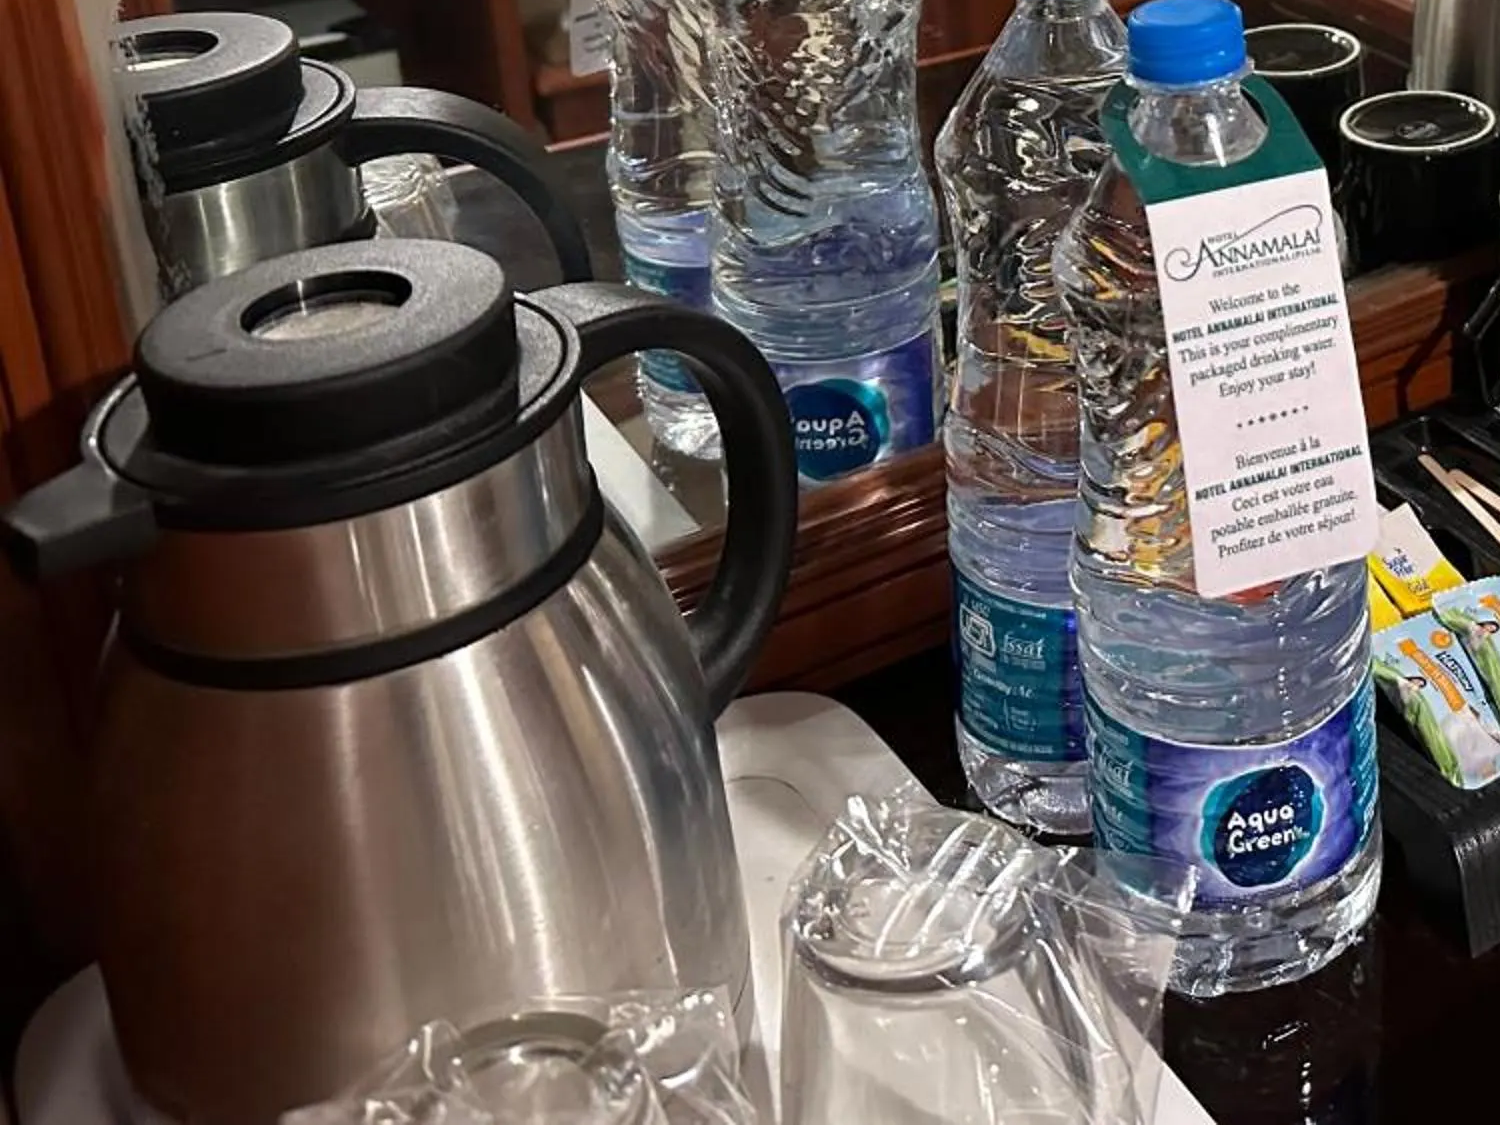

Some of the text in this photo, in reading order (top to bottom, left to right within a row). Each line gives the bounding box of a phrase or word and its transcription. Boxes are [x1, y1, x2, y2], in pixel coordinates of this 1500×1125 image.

[1197, 227, 1322, 269] ANNAMALAI
[1172, 293, 1340, 343] HOTEL ANNAMALAI INTERNATIONAL
[1209, 282, 1301, 314] Welcome to the
[1178, 315, 1339, 364] This is your complimentary
[1189, 359, 1247, 387] packaged
[1249, 344, 1300, 368] drinking
[1219, 361, 1317, 398] Enjoy your stay!
[1195, 445, 1363, 501] HOTEL ANNAMALAI INTERNATIONAL
[1235, 436, 1321, 470] Bienvenue à la
[1231, 474, 1335, 513] Ceci est votre eau
[1210, 514, 1256, 543] potable
[1257, 500, 1311, 527] emballée
[1217, 507, 1356, 559] Profitez de votre séjour!
[1227, 805, 1295, 833] Aqua
[1228, 828, 1297, 854] Green
